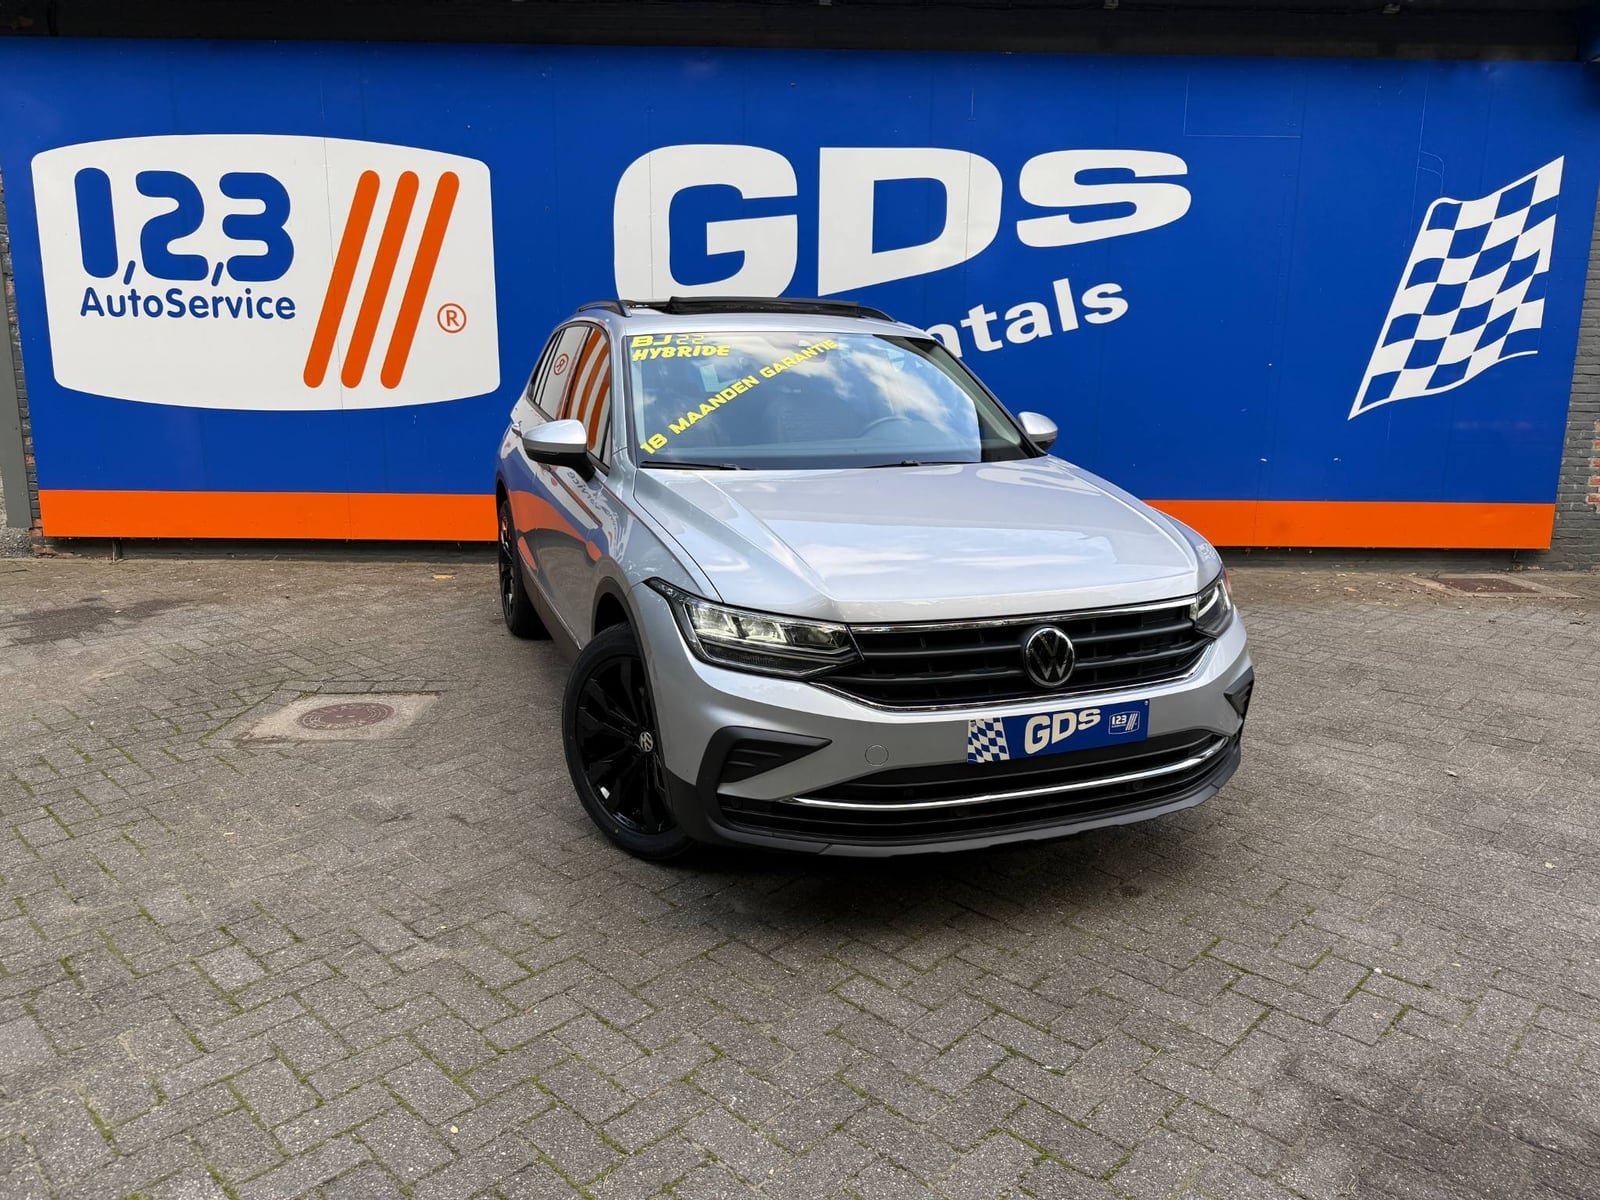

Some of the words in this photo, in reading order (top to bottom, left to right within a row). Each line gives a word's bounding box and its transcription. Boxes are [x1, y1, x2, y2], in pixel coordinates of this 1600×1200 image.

[613, 144, 1192, 301] GDS
[80, 286, 296, 320] AutoService
[631, 335, 673, 347] BJ
[631, 345, 730, 361] HYBRIDE
[640, 433, 668, 454] 18
[668, 375, 760, 435] MAANDEN
[759, 338, 839, 379] GARANTIE
[1024, 708, 1101, 754] GDS
